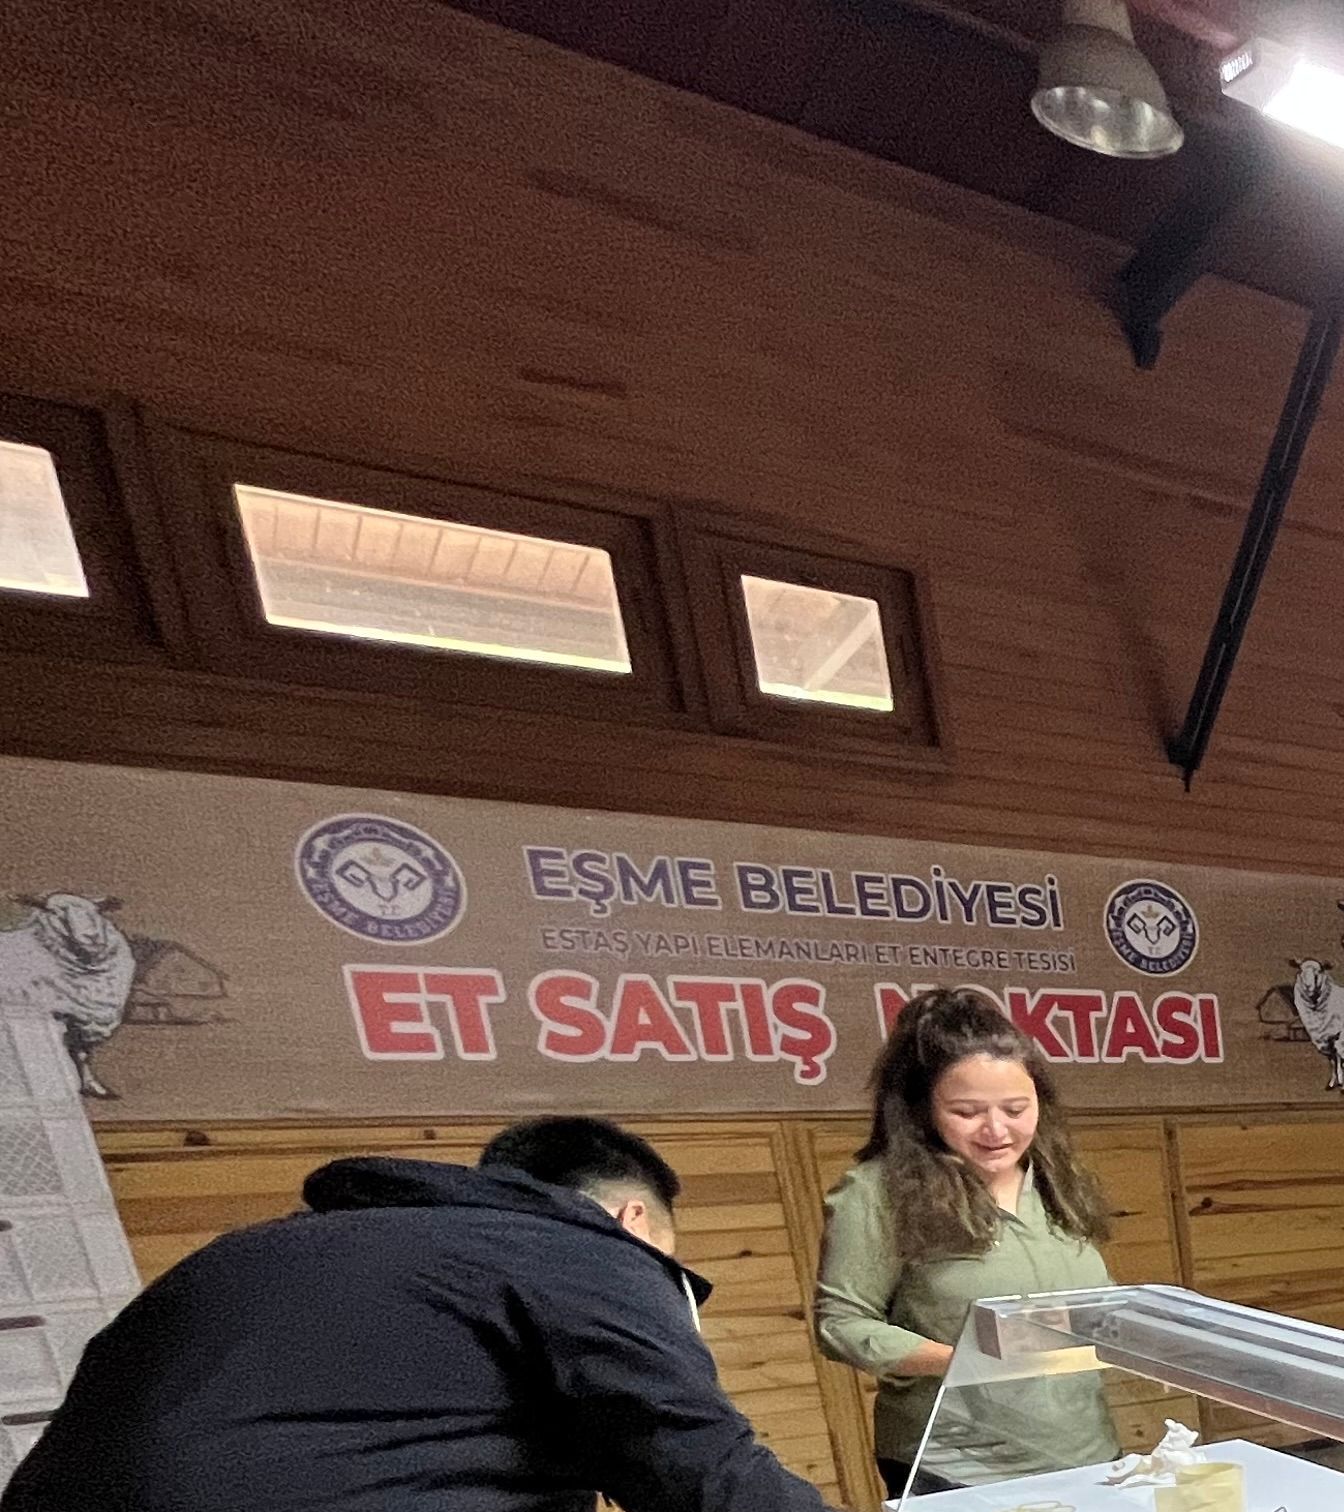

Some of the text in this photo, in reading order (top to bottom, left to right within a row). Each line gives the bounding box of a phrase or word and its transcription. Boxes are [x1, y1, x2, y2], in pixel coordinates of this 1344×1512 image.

[523, 845, 1064, 931] EŞME BELEDİYESİ
[541, 928, 627, 960] ESTAŞ
[635, 931, 699, 959] YAPI
[707, 934, 867, 966] ELEMANLARI
[877, 945, 899, 965] ET
[909, 946, 1010, 971] ENTEGRE
[342, 963, 1225, 1085] ET SATIŞ KTASI
